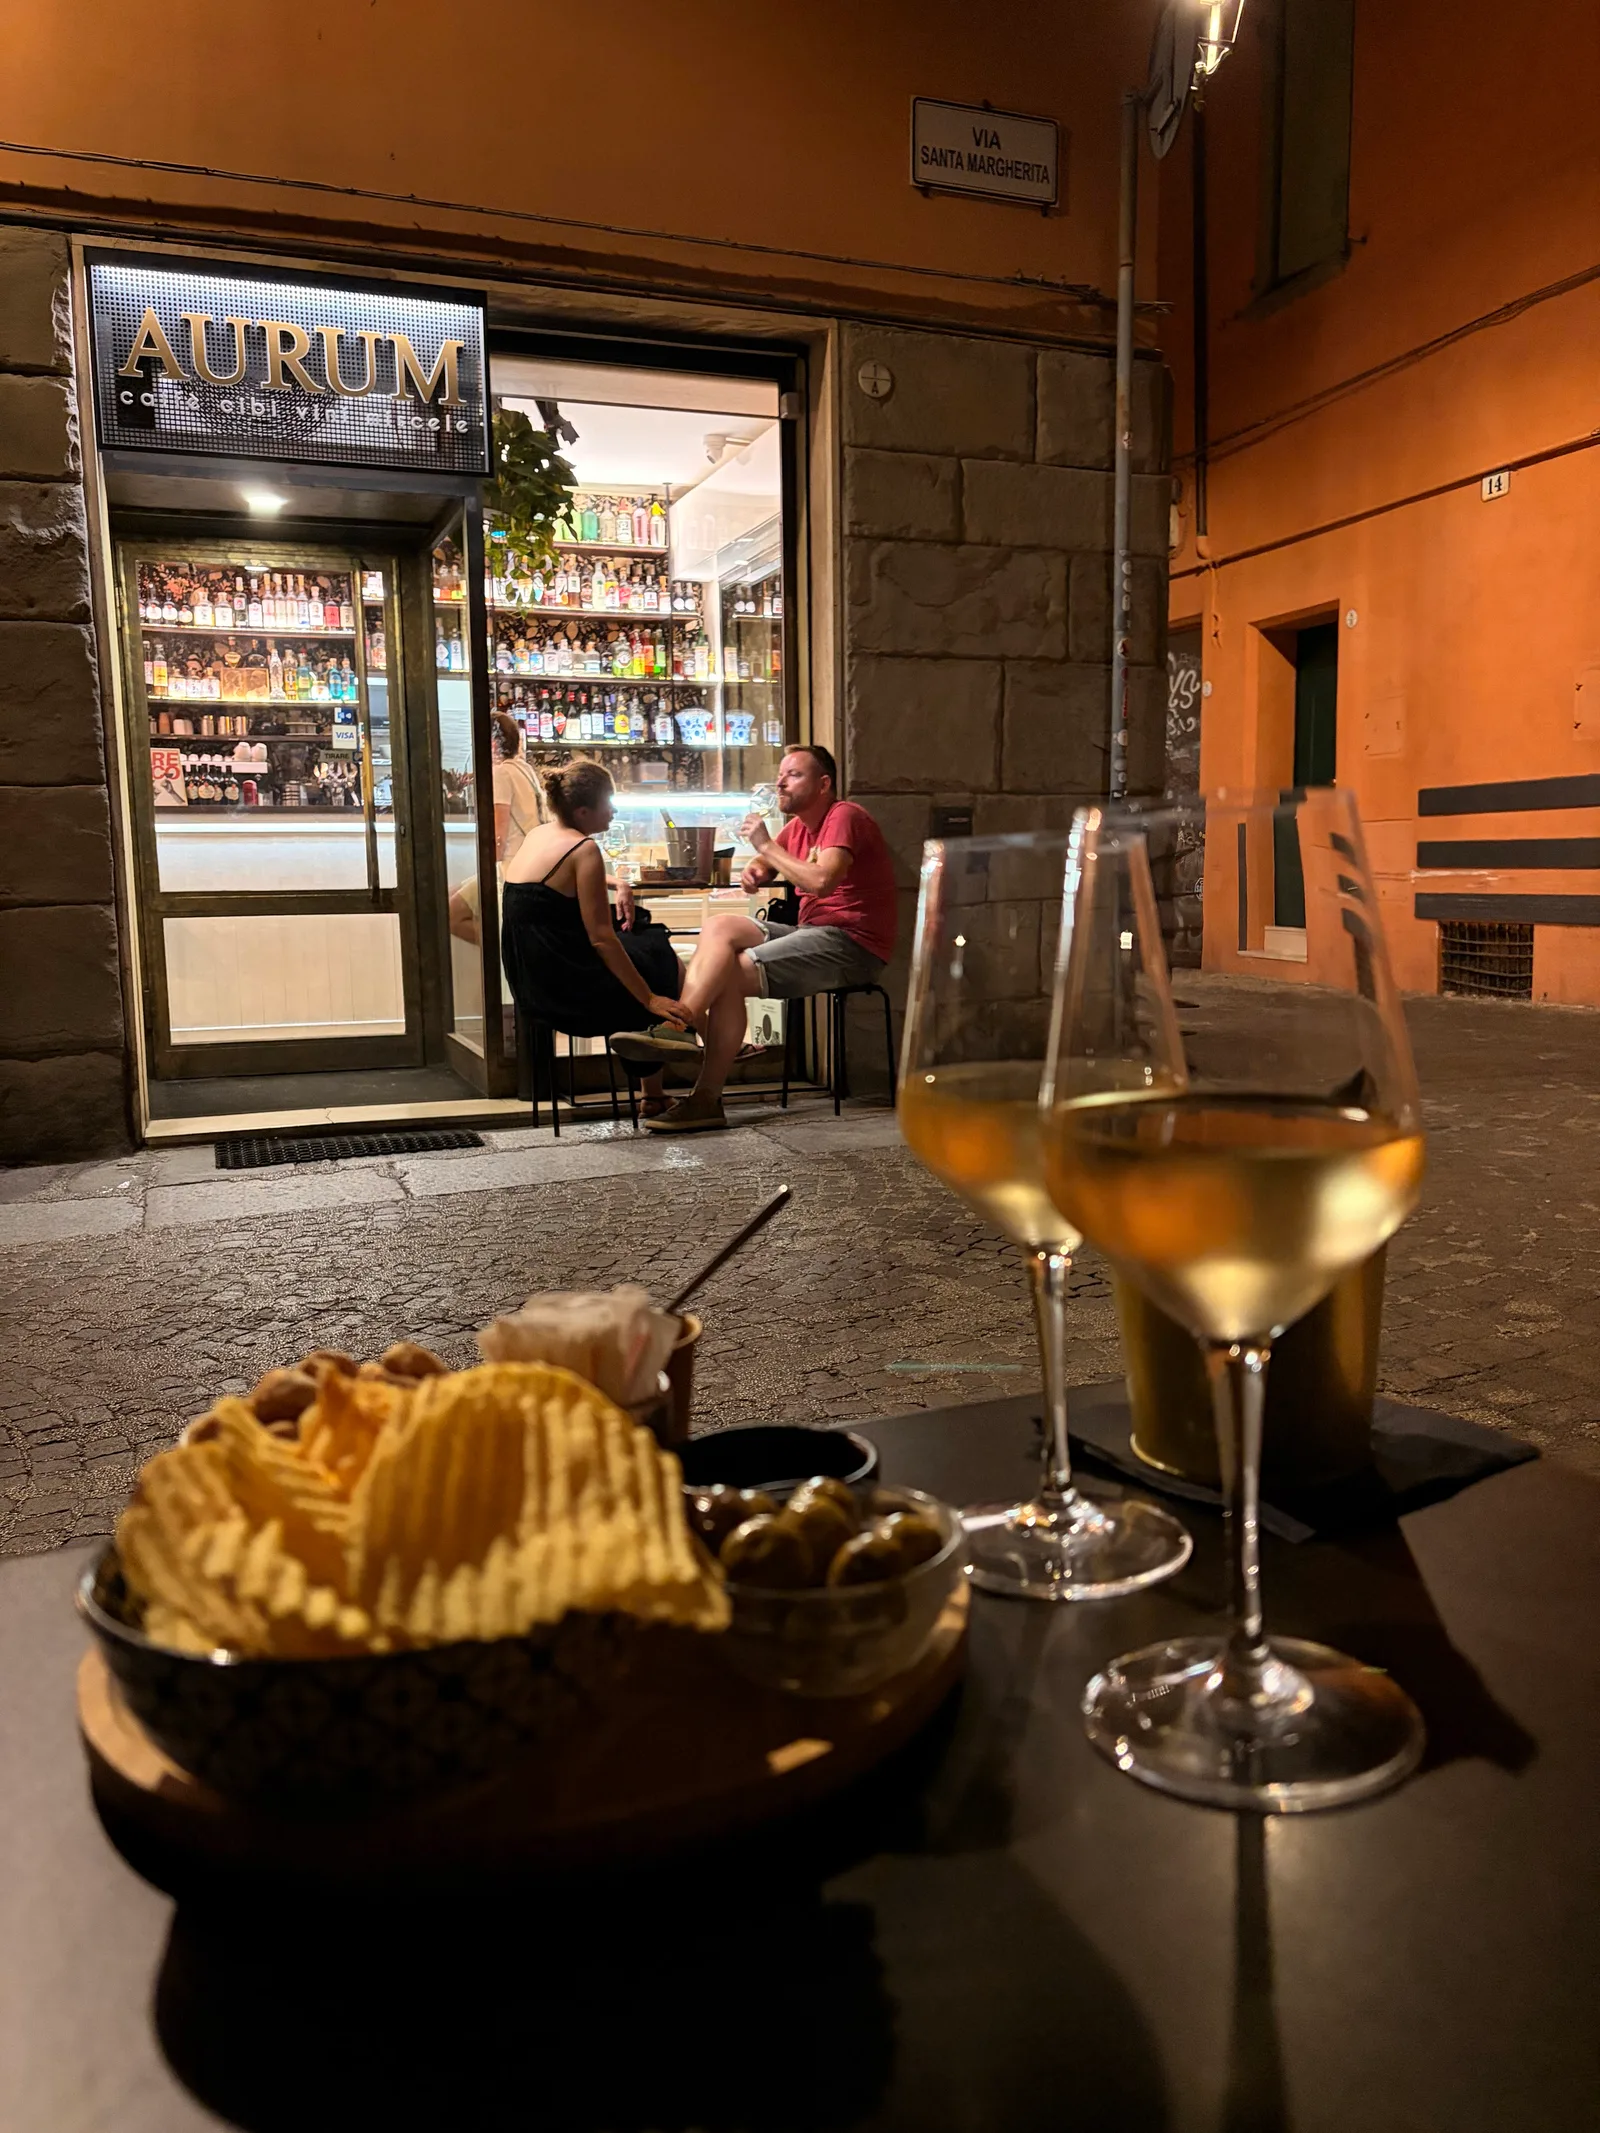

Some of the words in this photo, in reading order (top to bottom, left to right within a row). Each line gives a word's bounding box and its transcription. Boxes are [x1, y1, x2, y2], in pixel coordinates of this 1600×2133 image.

[972, 126, 1002, 150] VIA
[920, 145, 964, 172] SANTA
[966, 152, 1051, 185] MARGHERITA
[118, 305, 468, 408] AURUM
[219, 396, 278, 417] cibi
[295, 403, 350, 424] vini
[1487, 475, 1503, 495] 14
[335, 731, 355, 740] VISA
[152, 752, 179, 766] RE
[152, 766, 181, 780] CO
